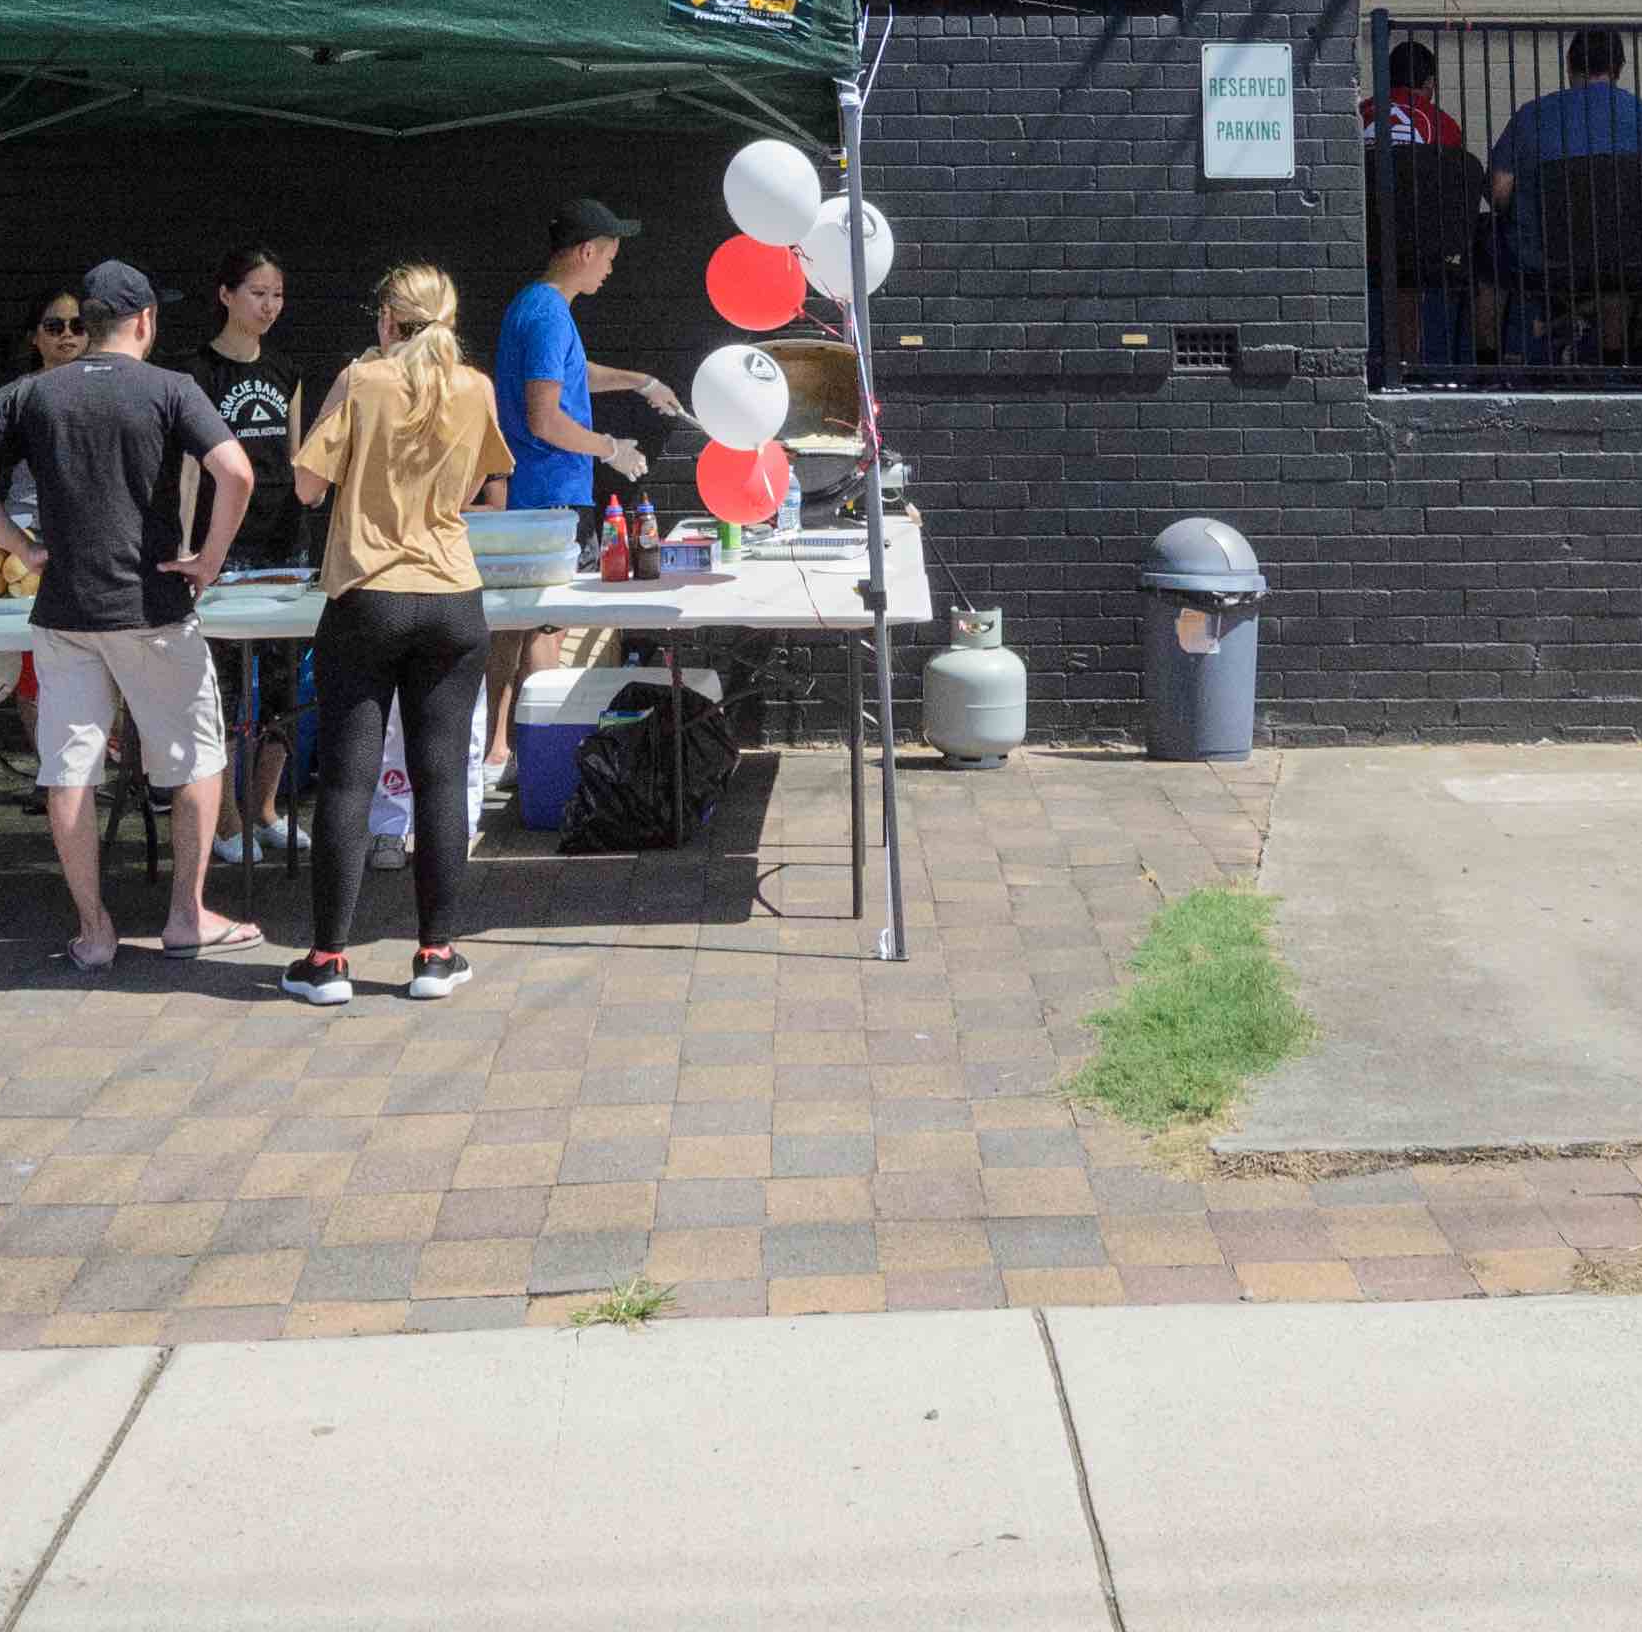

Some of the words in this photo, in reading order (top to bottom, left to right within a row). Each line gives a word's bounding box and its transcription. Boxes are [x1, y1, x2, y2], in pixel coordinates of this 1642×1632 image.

[1209, 78, 1286, 97] RESERVED
[1217, 120, 1281, 141] PARKING
[219, 380, 253, 418] GRACIE
